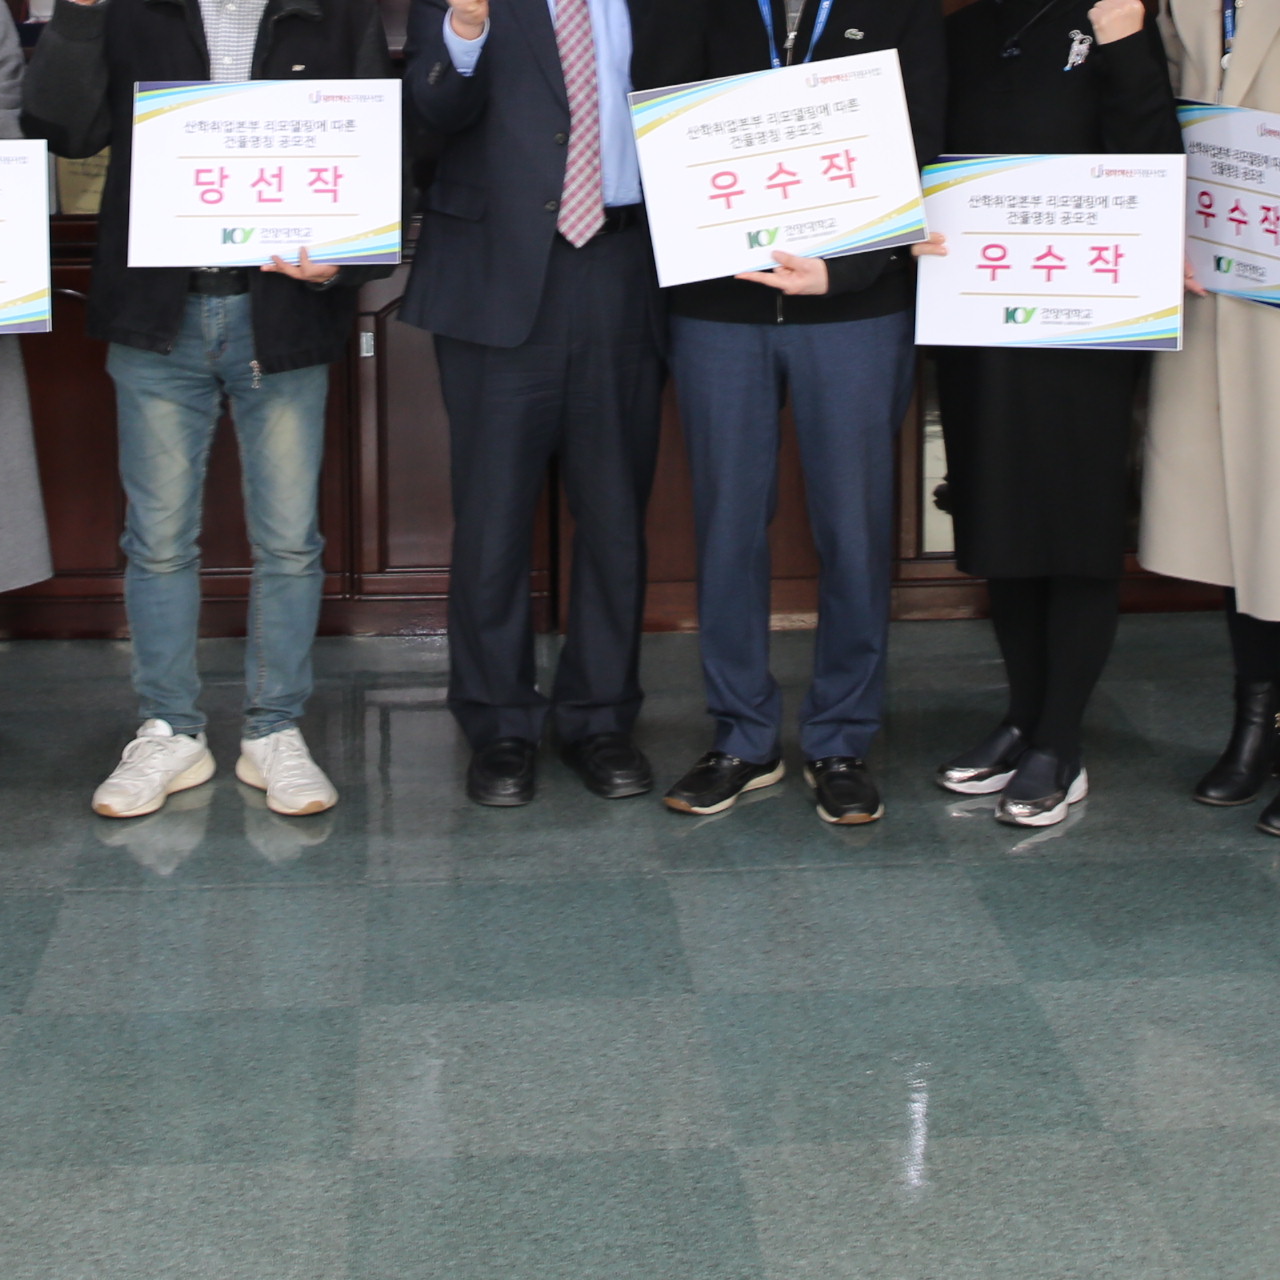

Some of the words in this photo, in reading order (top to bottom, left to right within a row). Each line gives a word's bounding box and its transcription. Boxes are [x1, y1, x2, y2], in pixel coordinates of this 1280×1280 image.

[184, 120, 261, 133] 산학취업본부
[330, 120, 357, 132] 따른
[686, 115, 763, 140] 산학취업본부
[833, 98, 861, 115] 따른
[223, 135, 275, 149] 건물명칭
[278, 135, 316, 148] 공모전
[730, 129, 780, 149] 건물명칭
[785, 122, 823, 139] 공모전
[968, 195, 1042, 210] 산학취업본부
[1112, 196, 1139, 210] 따른
[1006, 210, 1056, 226] 건물명칭
[1060, 212, 1098, 226] 공모전
